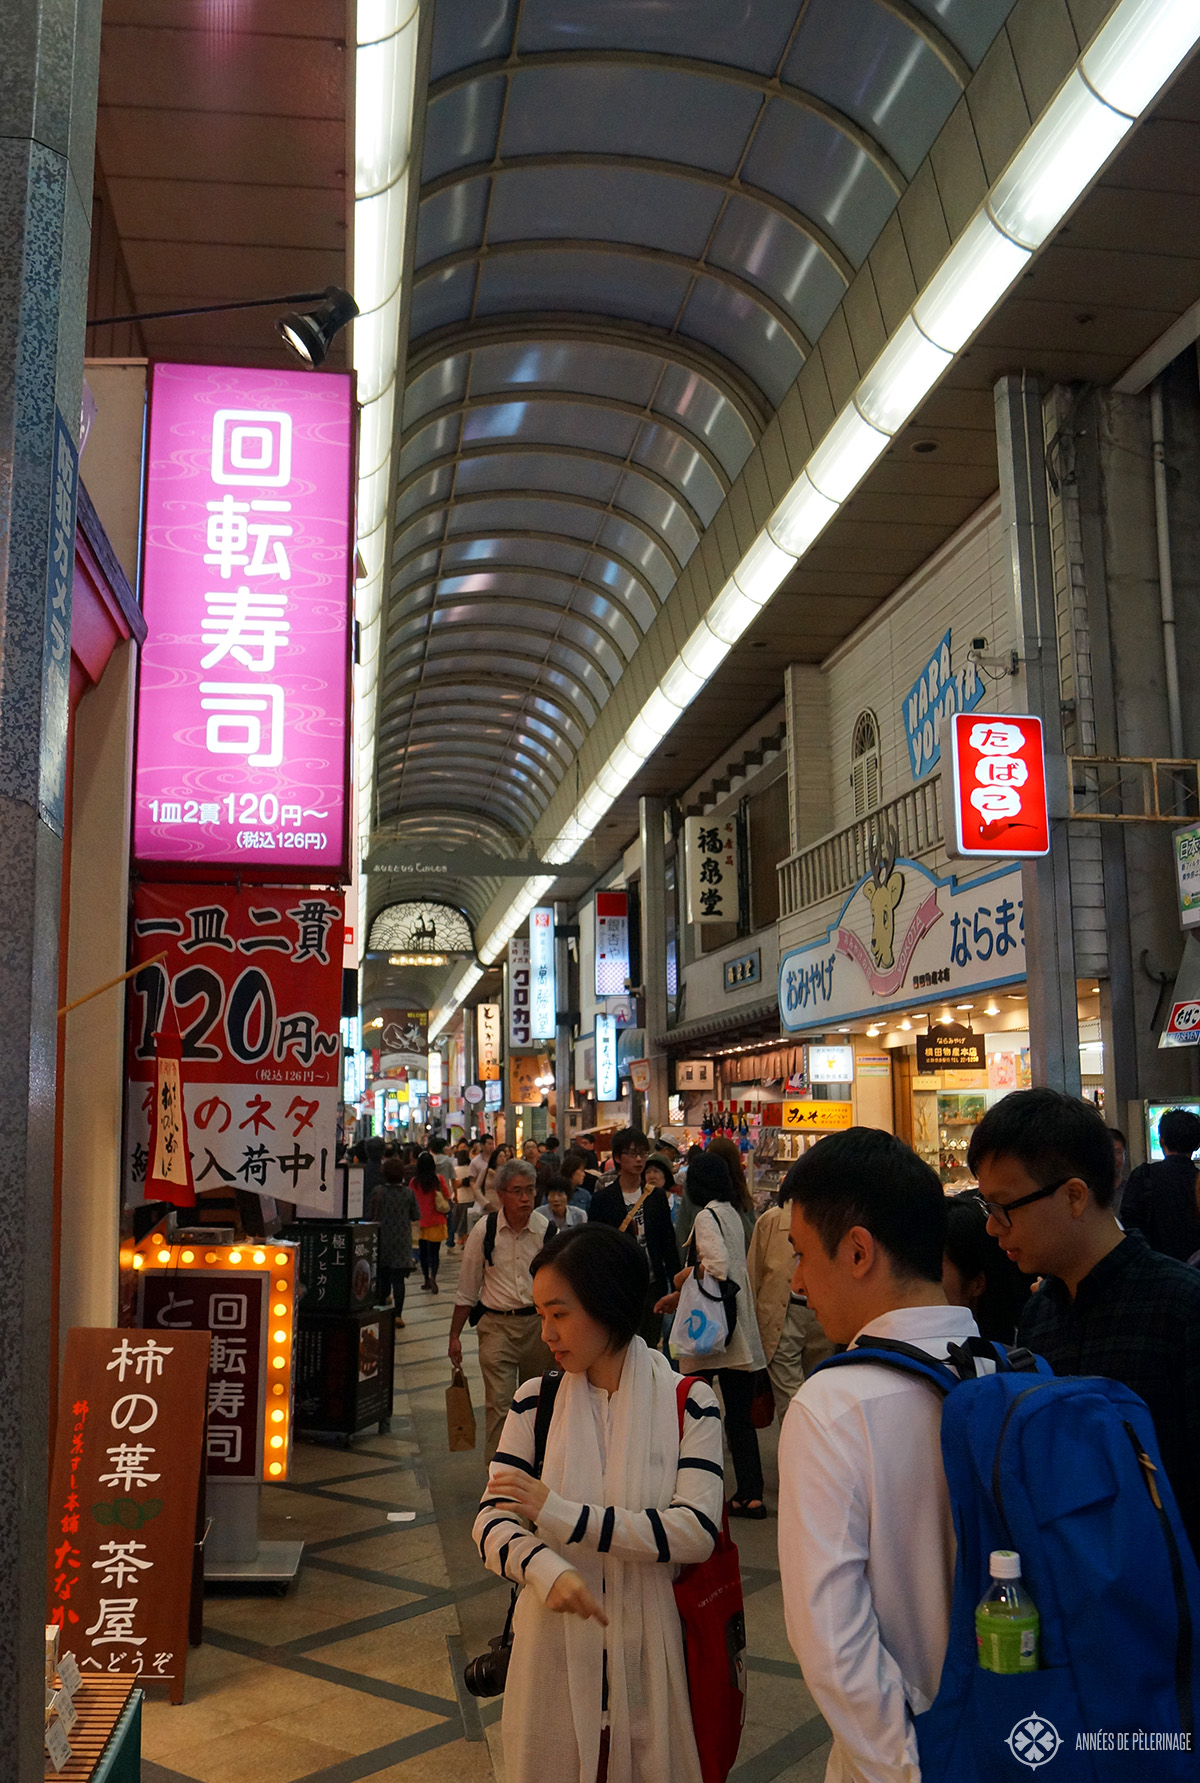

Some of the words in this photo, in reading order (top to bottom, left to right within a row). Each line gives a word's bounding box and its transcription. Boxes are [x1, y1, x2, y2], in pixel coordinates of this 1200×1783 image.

[199, 409, 293, 768] 回転寿司
[908, 642, 950, 735] NARA
[980, 729, 1019, 811] たばこ
[236, 831, 328, 851] (税込126円)
[697, 827, 723, 916] 福泉堂
[1180, 835, 1200, 860] 日本
[134, 899, 341, 966] 一皿二貫
[950, 898, 1026, 968] ならま
[513, 969, 530, 1044] クロカワ
[786, 953, 836, 1012] おみやげ
[1176, 1009, 1200, 1026] たばこ
[787, 1108, 818, 1124] みそ
[316, 1232, 328, 1301] ヒノヒカリ
[332, 1233, 345, 1266] 極上
[208, 1293, 248, 1463] 回転寿司
